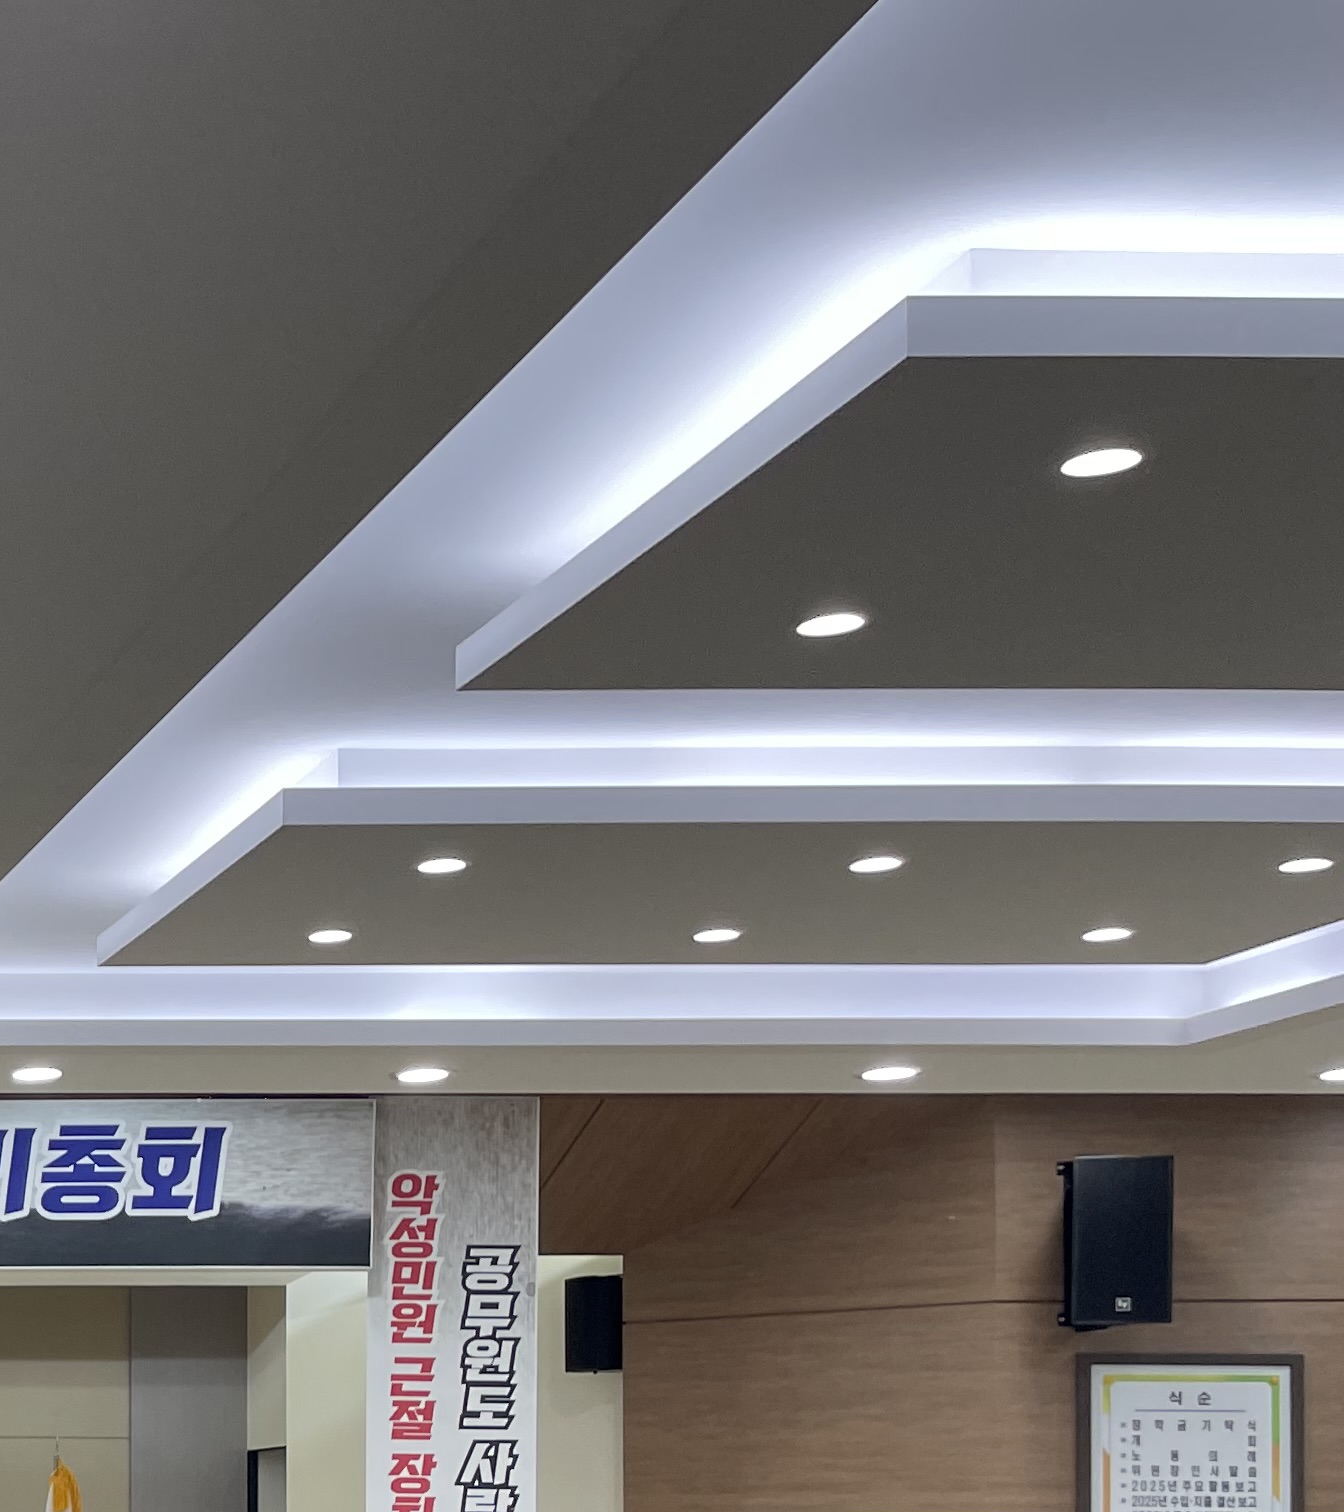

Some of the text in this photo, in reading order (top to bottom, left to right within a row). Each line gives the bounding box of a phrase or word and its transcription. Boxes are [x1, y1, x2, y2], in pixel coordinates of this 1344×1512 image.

[389, 1174, 438, 1343] 악성민원
[459, 1245, 520, 1430] 공무원도
[388, 1357, 436, 1440] 근절
